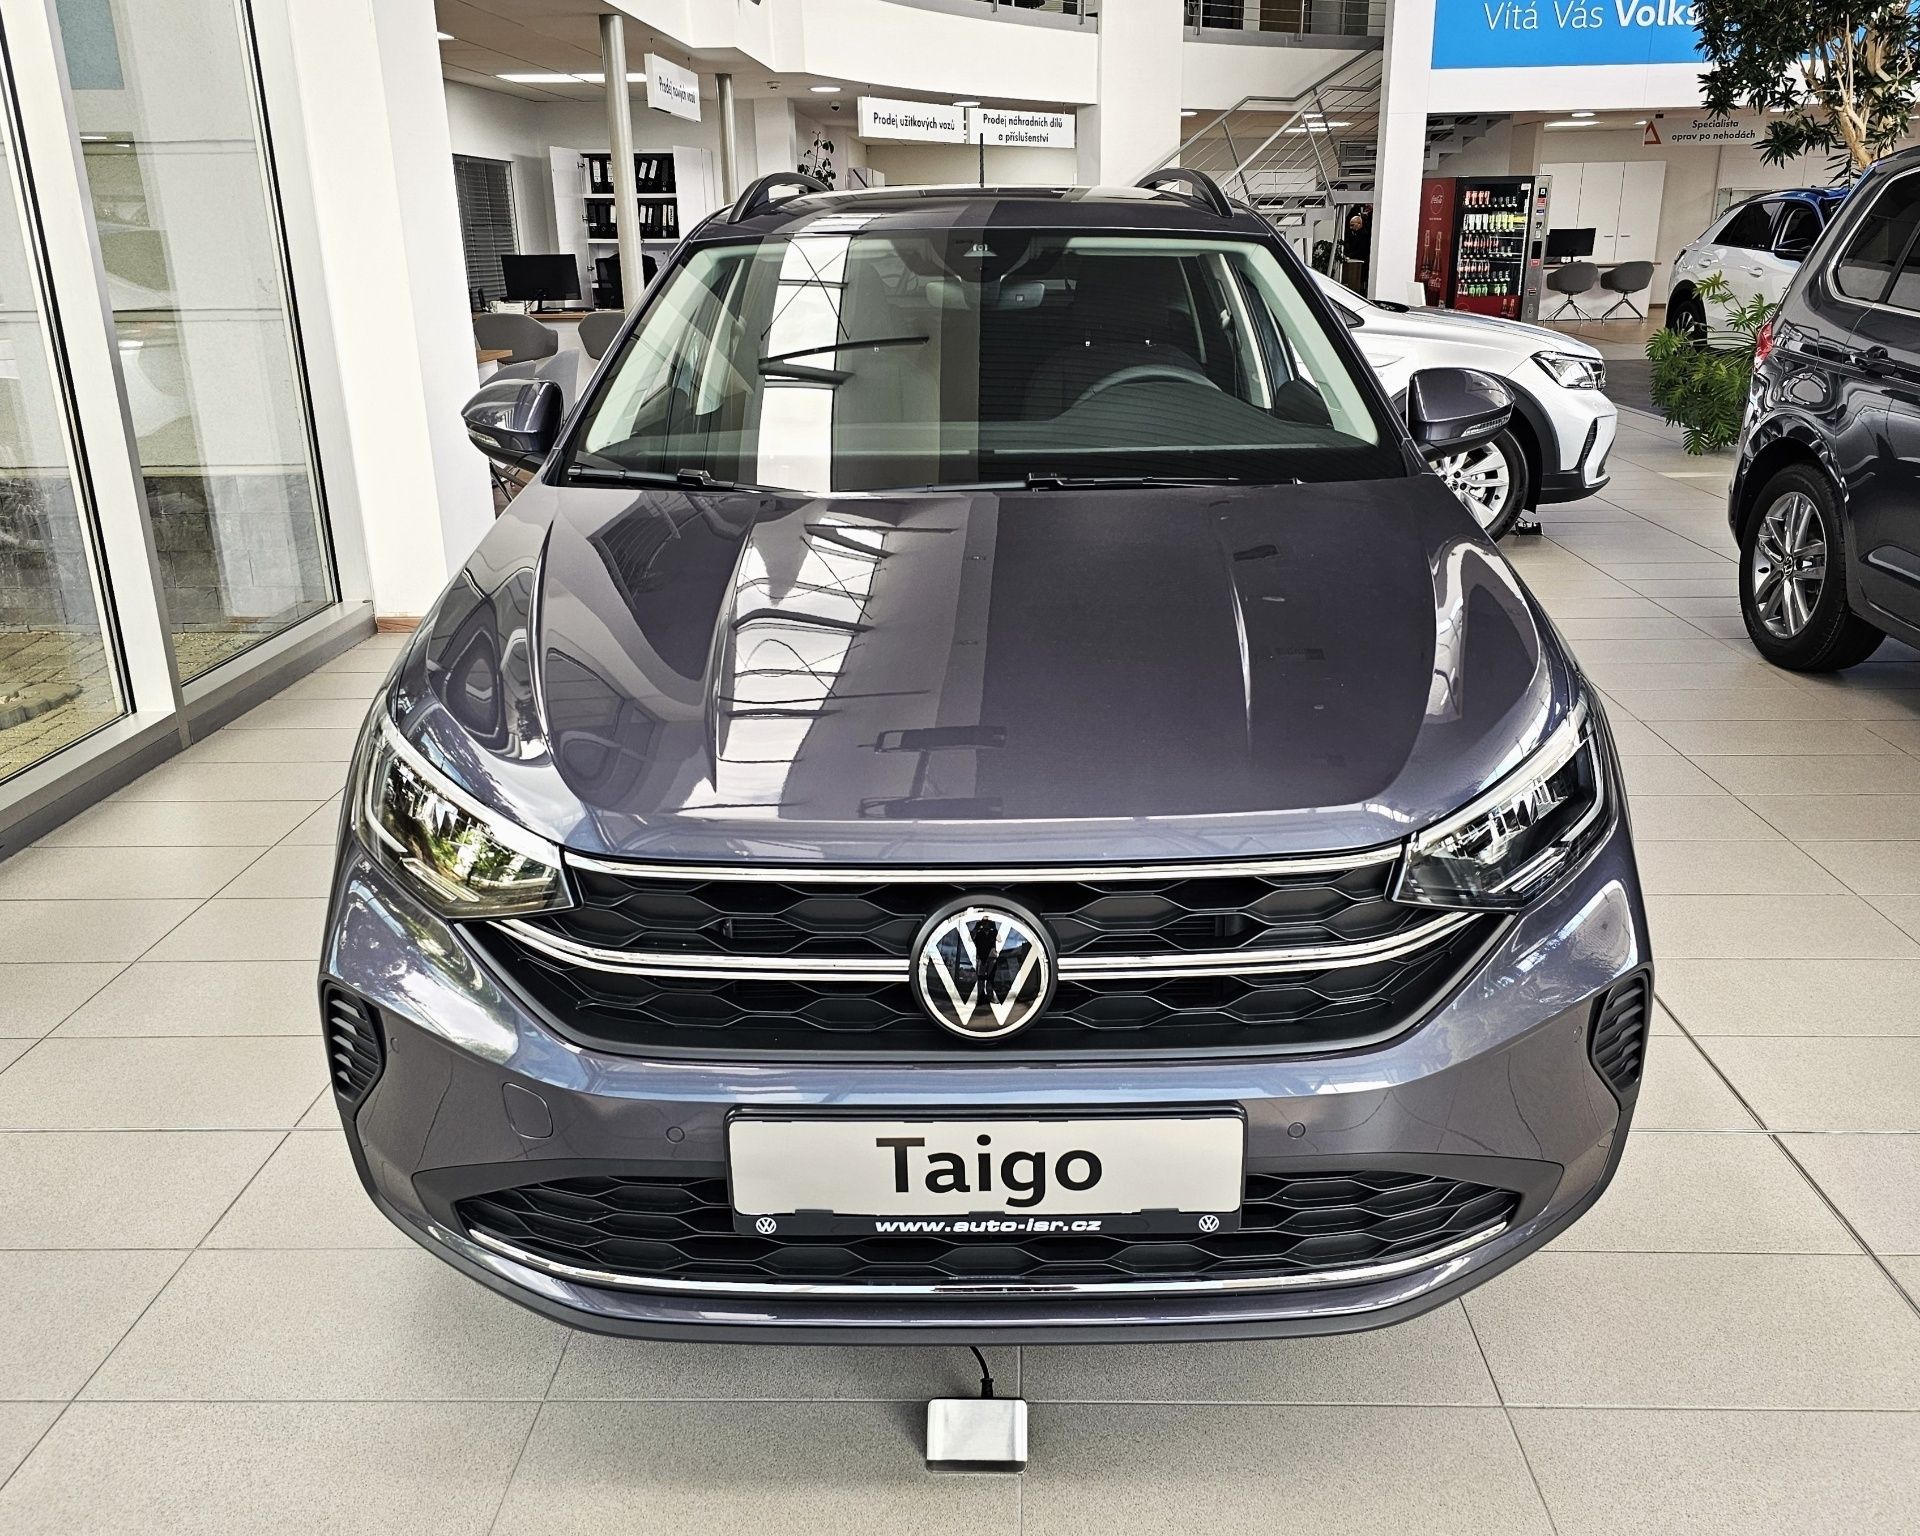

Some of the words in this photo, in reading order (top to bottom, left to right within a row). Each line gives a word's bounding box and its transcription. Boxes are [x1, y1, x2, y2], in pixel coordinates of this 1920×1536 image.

[1484, 0, 1539, 31] Vítá
[1553, 0, 1604, 29] Vás
[873, 111, 898, 129] Prodej
[982, 113, 1007, 128] Prodej
[1692, 119, 1739, 130] Specialista
[1671, 132, 1697, 142] oprav
[1699, 132, 1711, 142] po
[1712, 129, 1756, 140] nehodách
[875, 1133, 1103, 1208] Taigo
[875, 1217, 1102, 1233] www.auto-isr.cz
